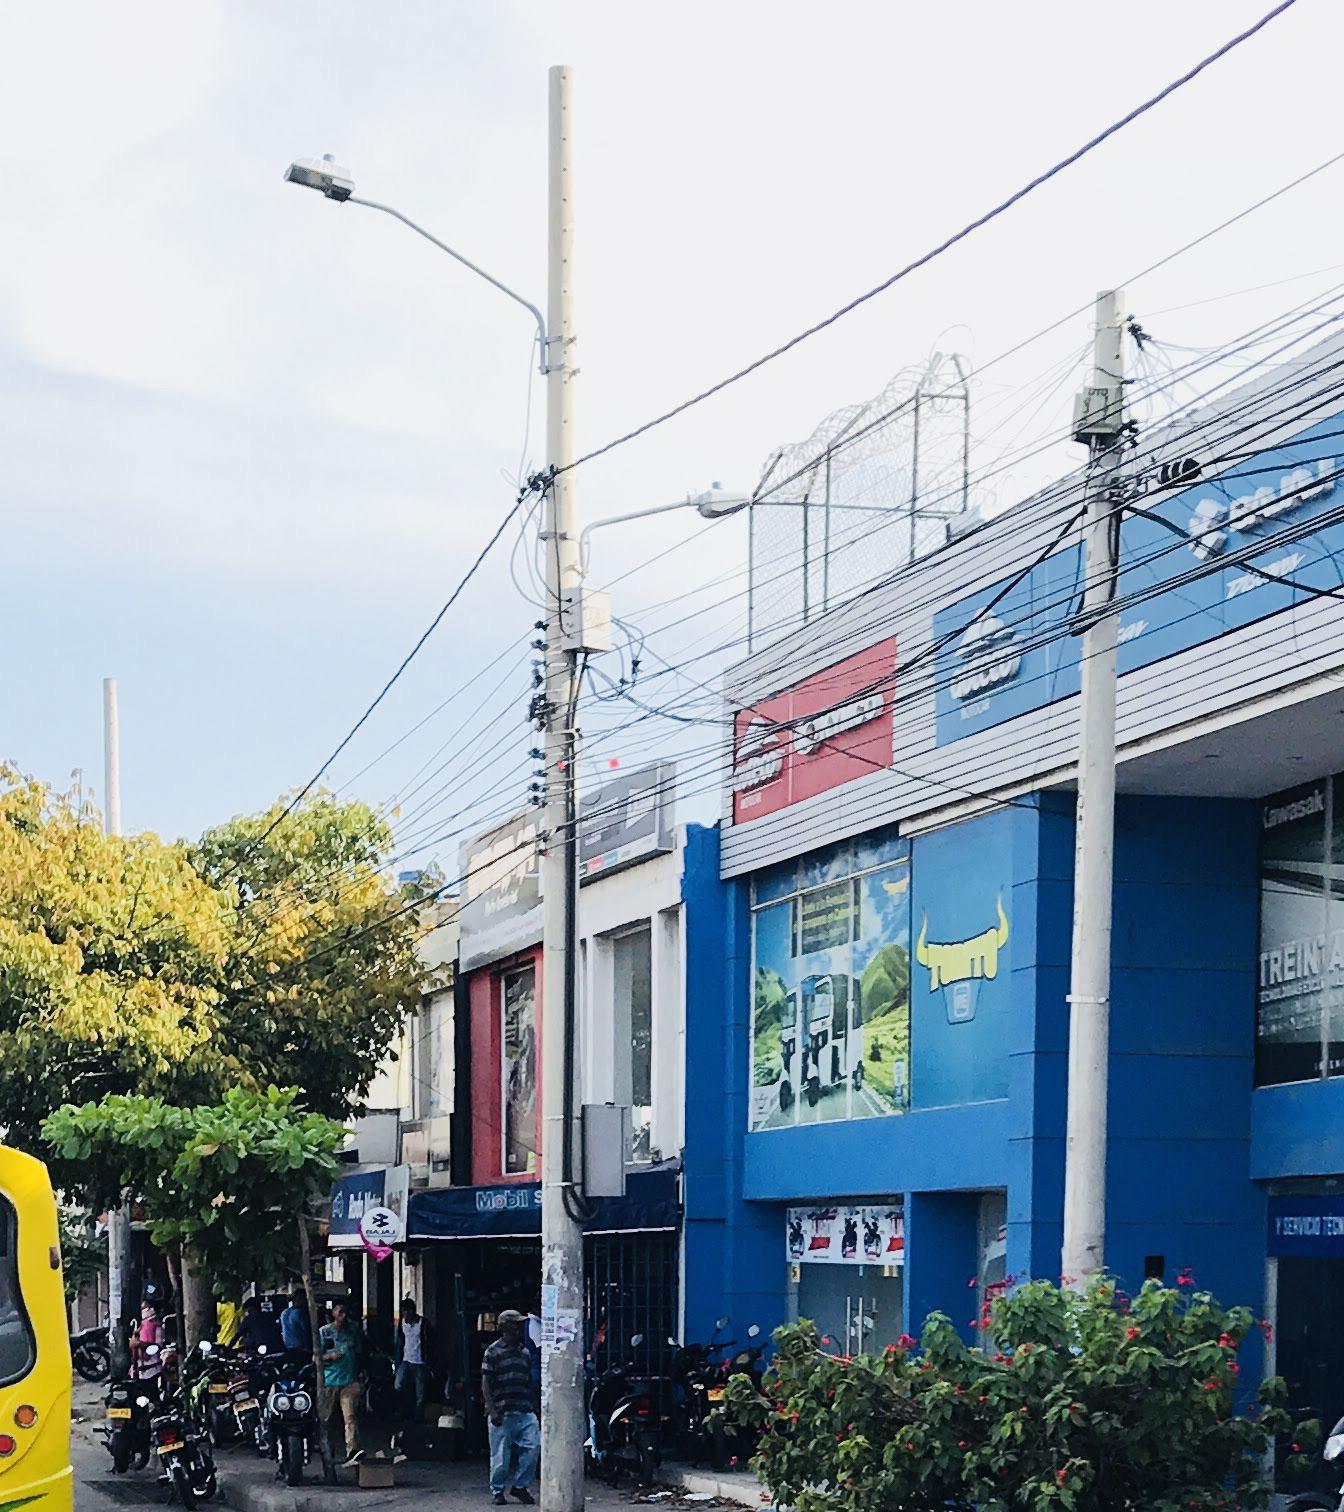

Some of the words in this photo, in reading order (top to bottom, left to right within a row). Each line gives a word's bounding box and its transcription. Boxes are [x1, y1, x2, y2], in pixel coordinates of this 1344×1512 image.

[1263, 788, 1326, 829] Kawasak
[475, 1190, 529, 1211] Mobil
[1283, 1216, 1321, 1236] SERVICIO
